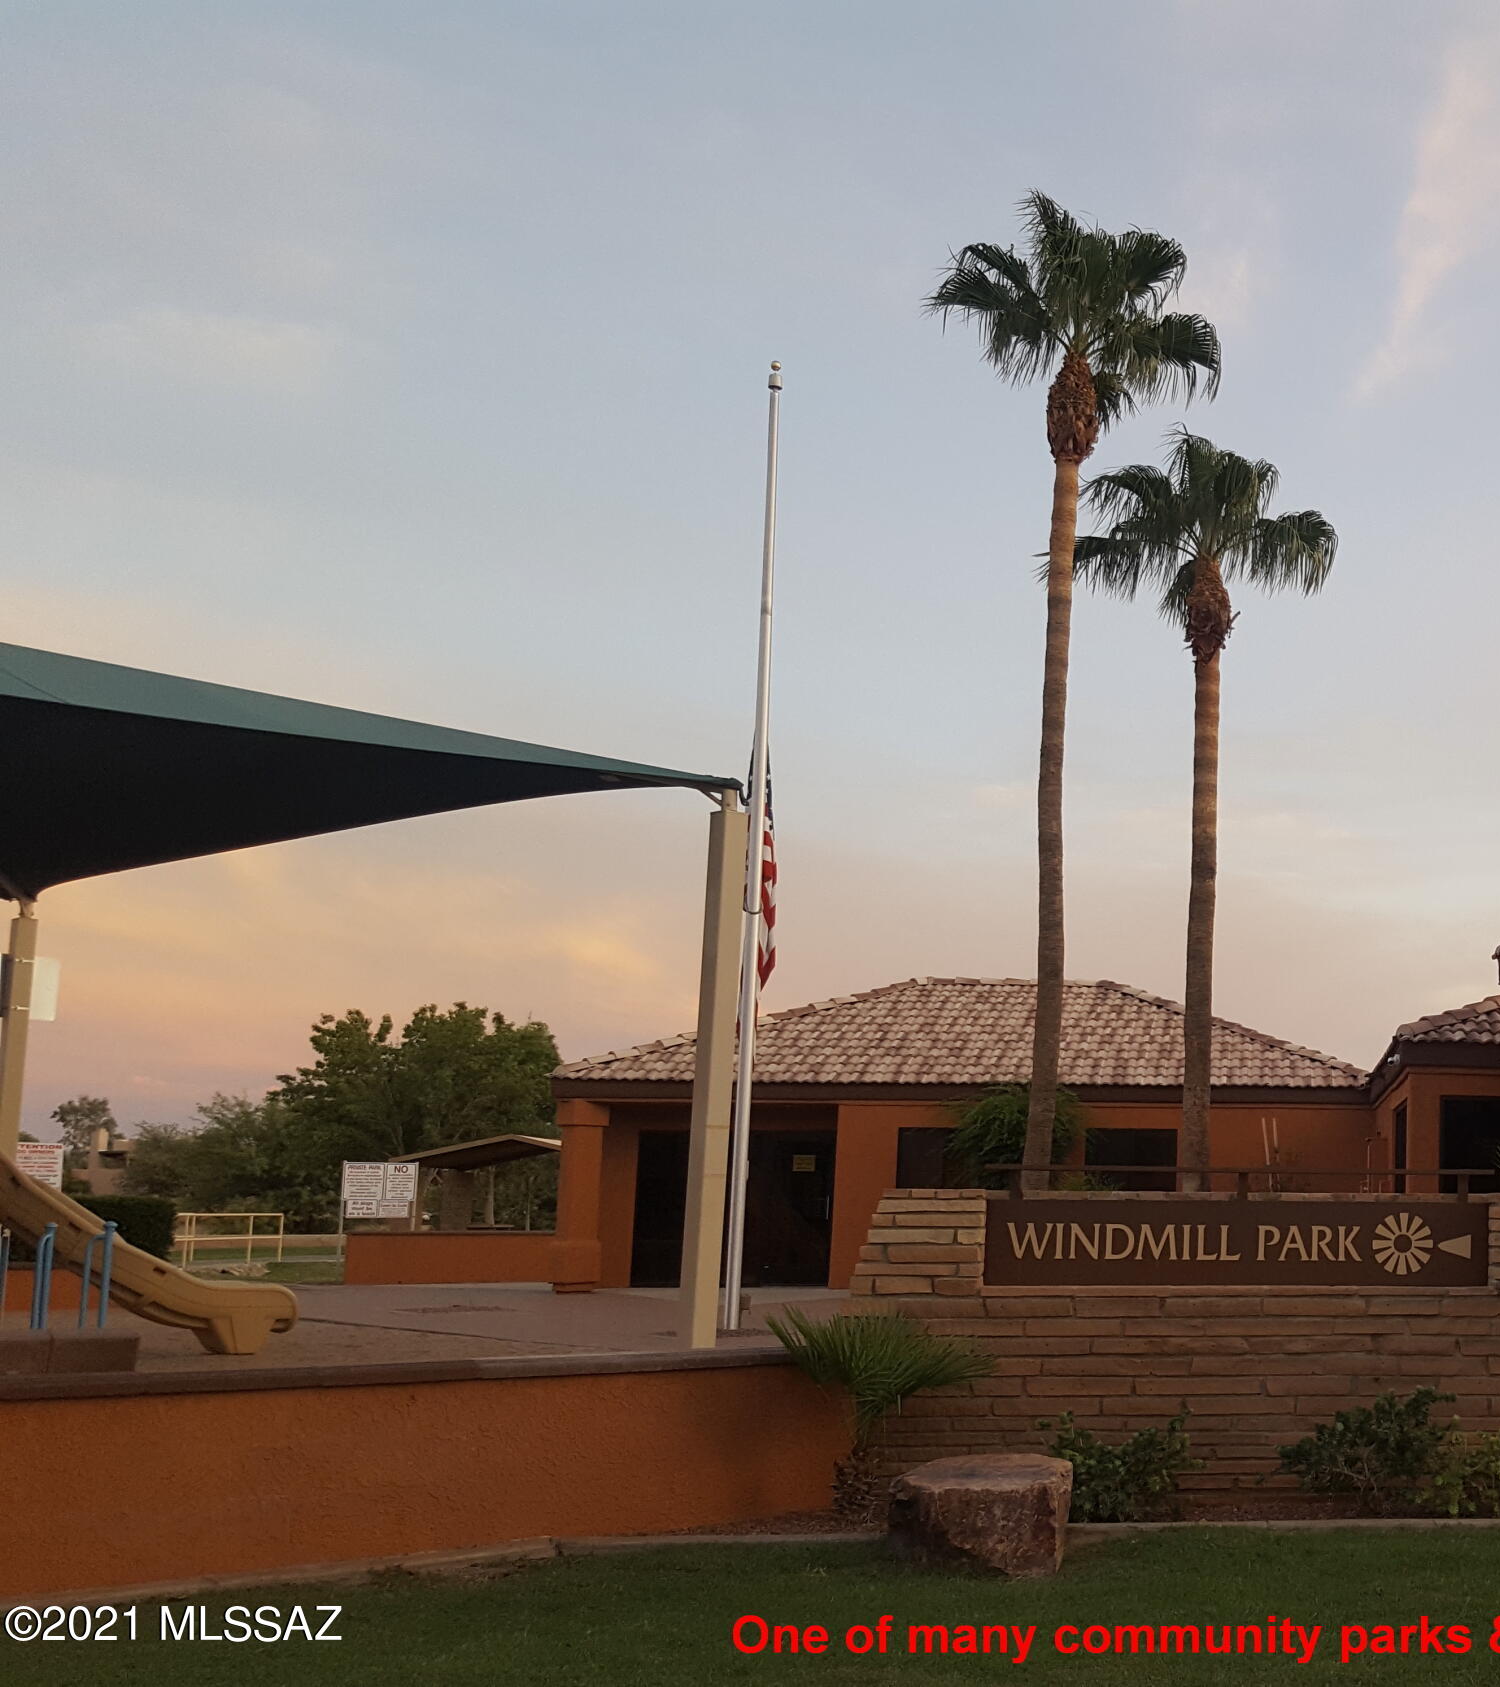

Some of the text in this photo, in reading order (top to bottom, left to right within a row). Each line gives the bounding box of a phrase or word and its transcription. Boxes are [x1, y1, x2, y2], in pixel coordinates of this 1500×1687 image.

[394, 1165, 409, 1174] NO
[1006, 1221, 1363, 1263] WINDMILL PARK
